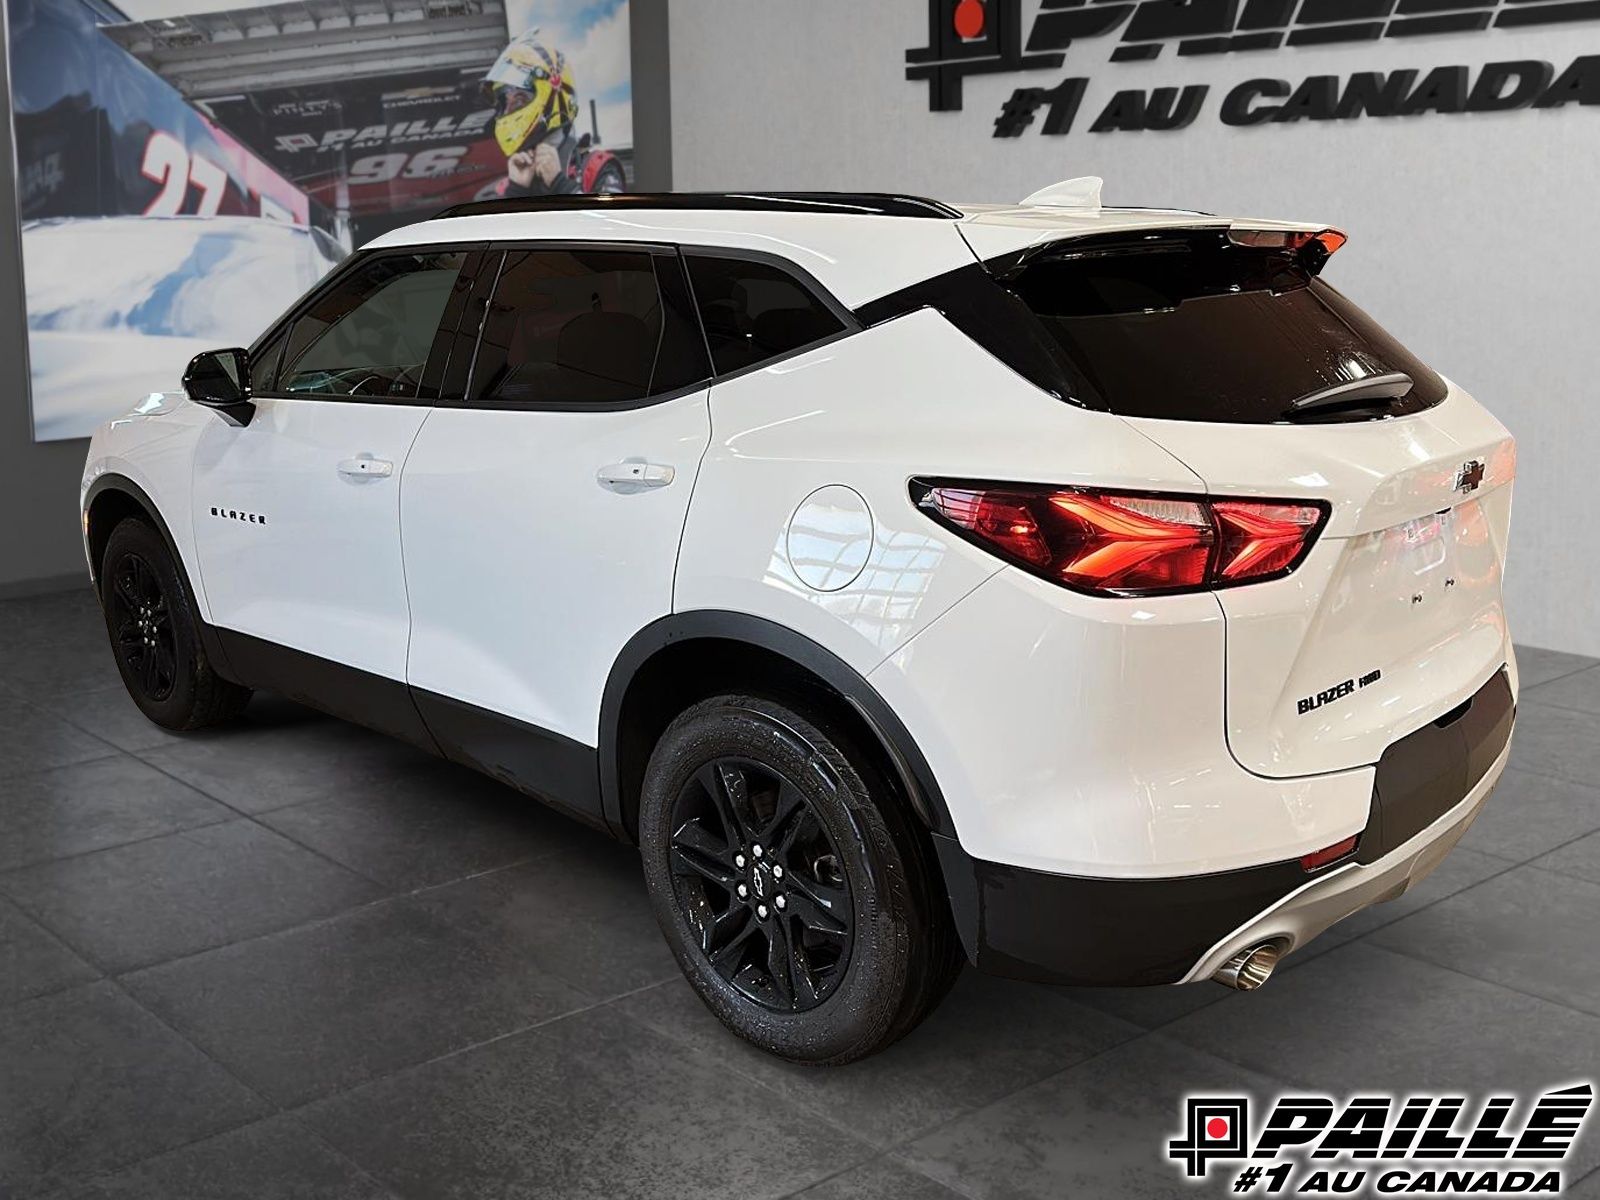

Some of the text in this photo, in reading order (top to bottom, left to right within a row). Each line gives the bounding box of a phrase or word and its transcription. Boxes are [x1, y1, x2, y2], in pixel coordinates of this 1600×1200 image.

[993, 55, 1600, 138] #1 AU CANADA
[141, 130, 228, 217] 27
[348, 146, 468, 184] 96
[210, 506, 266, 525] BLAZER
[1297, 679, 1355, 715] BLAZER
